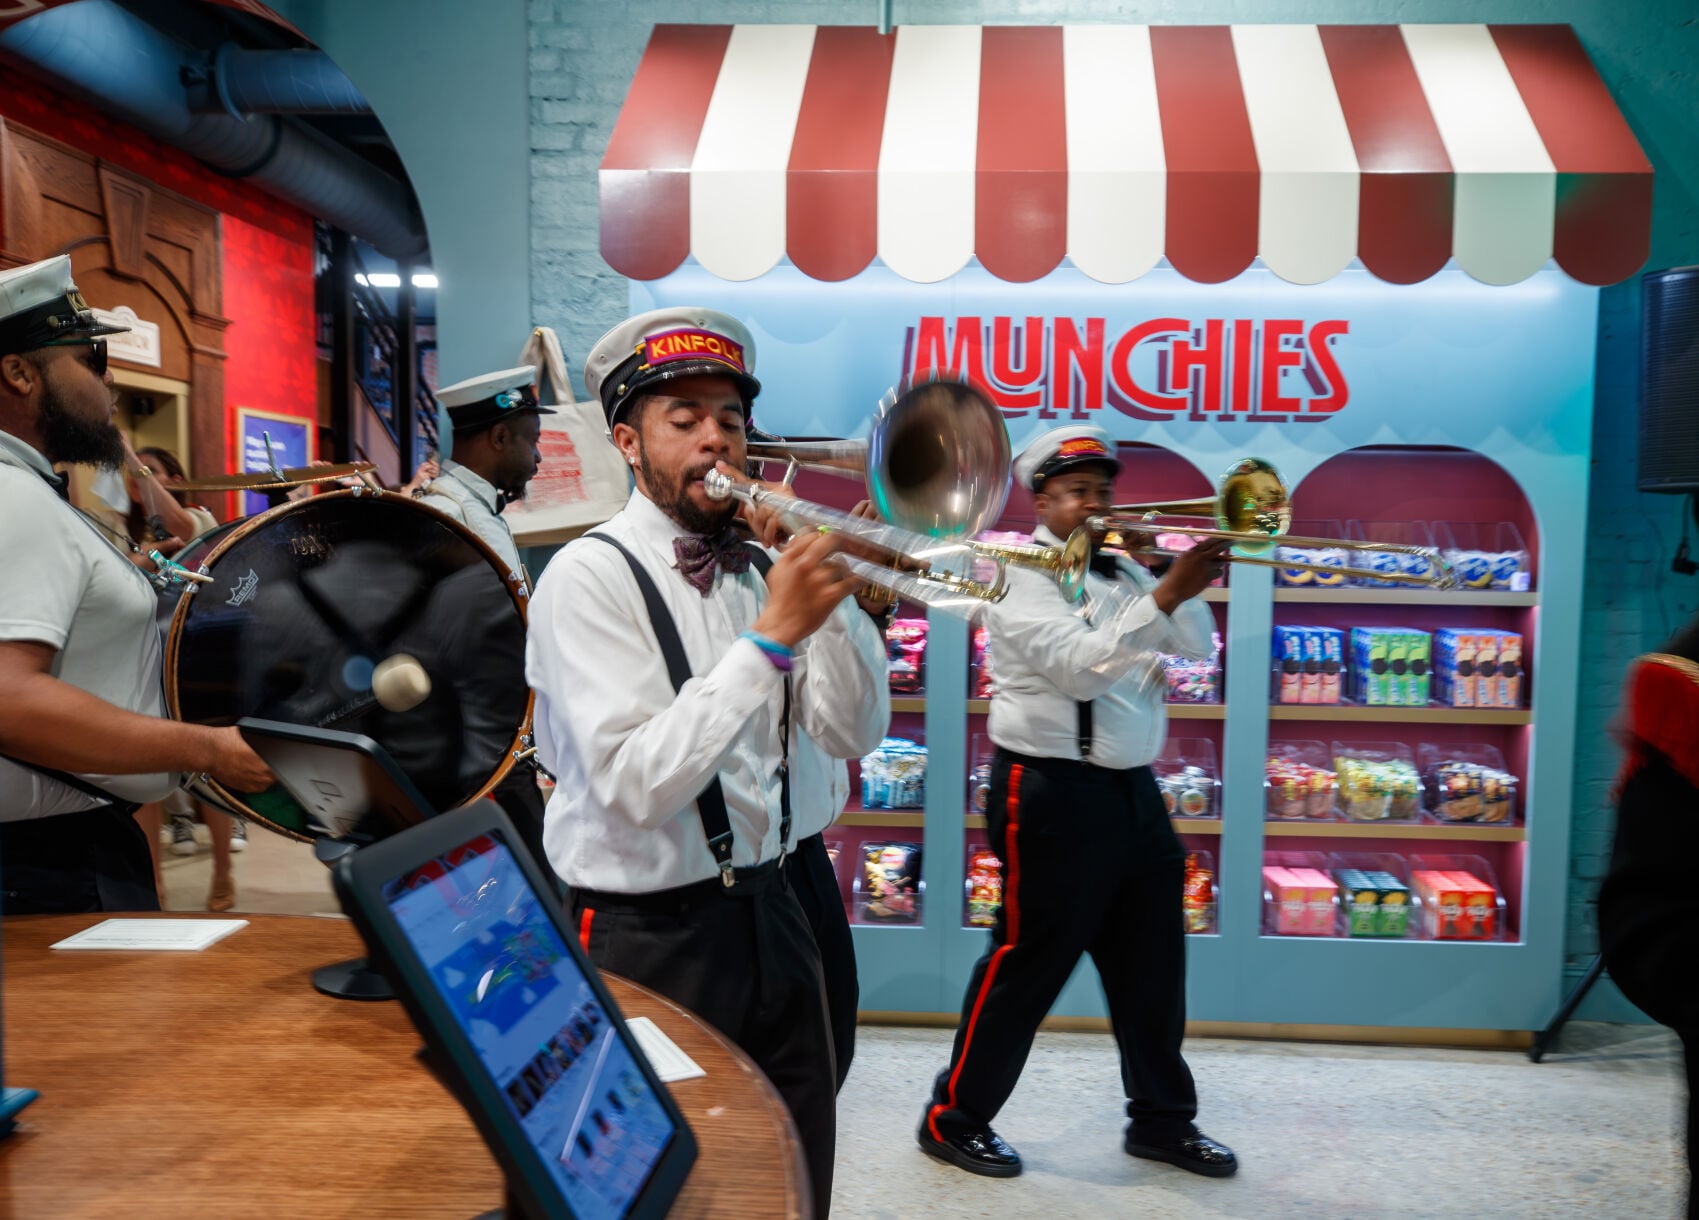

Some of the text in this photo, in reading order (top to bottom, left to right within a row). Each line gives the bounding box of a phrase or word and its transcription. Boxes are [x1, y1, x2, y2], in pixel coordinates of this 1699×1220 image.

[651, 335, 741, 363] KINFOLK
[906, 316, 1351, 417] MUNCHIES
[234, 576, 256, 602] REMO
